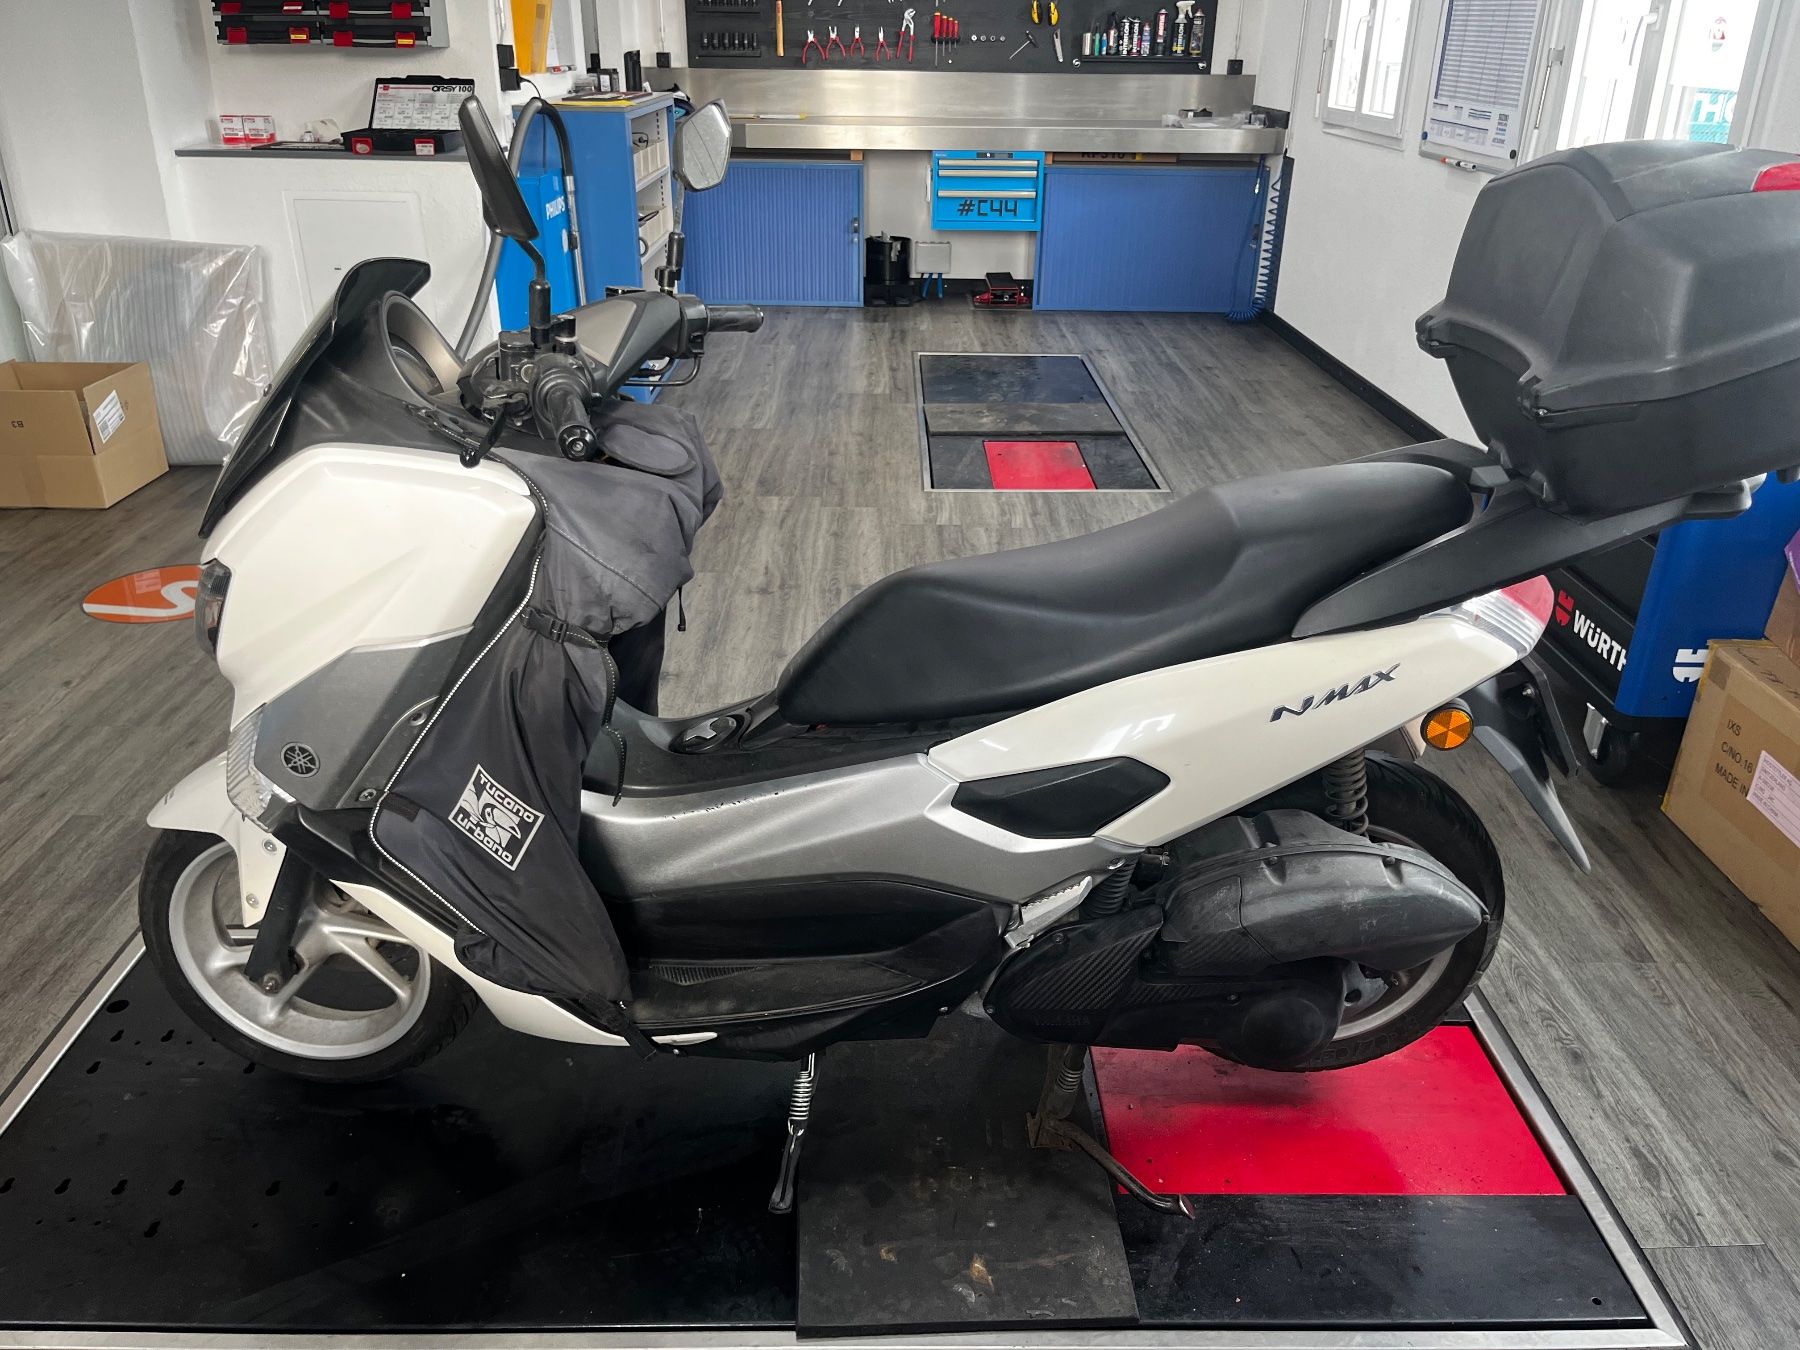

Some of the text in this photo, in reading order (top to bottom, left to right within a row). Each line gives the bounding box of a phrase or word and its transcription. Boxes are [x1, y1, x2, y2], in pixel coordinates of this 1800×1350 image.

[957, 199, 1018, 217] #C44
[1726, 718, 1742, 737] IXS
[1715, 762, 1738, 789] MADE
